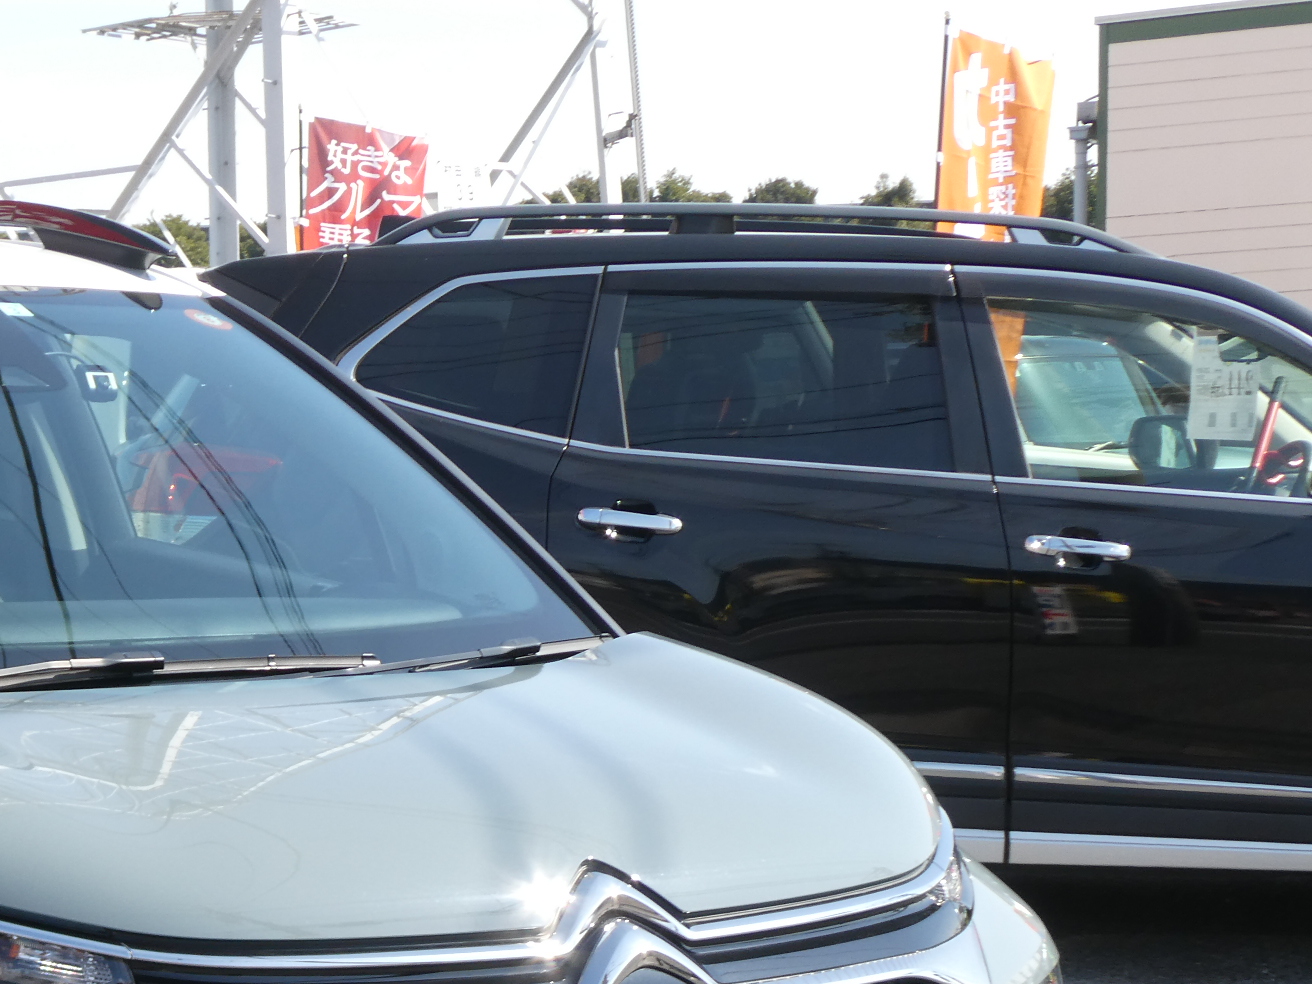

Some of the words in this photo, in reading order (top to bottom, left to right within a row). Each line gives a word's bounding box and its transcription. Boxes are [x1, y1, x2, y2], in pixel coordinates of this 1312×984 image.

[325, 139, 413, 185] 好きな
[308, 172, 422, 222] クルマ
